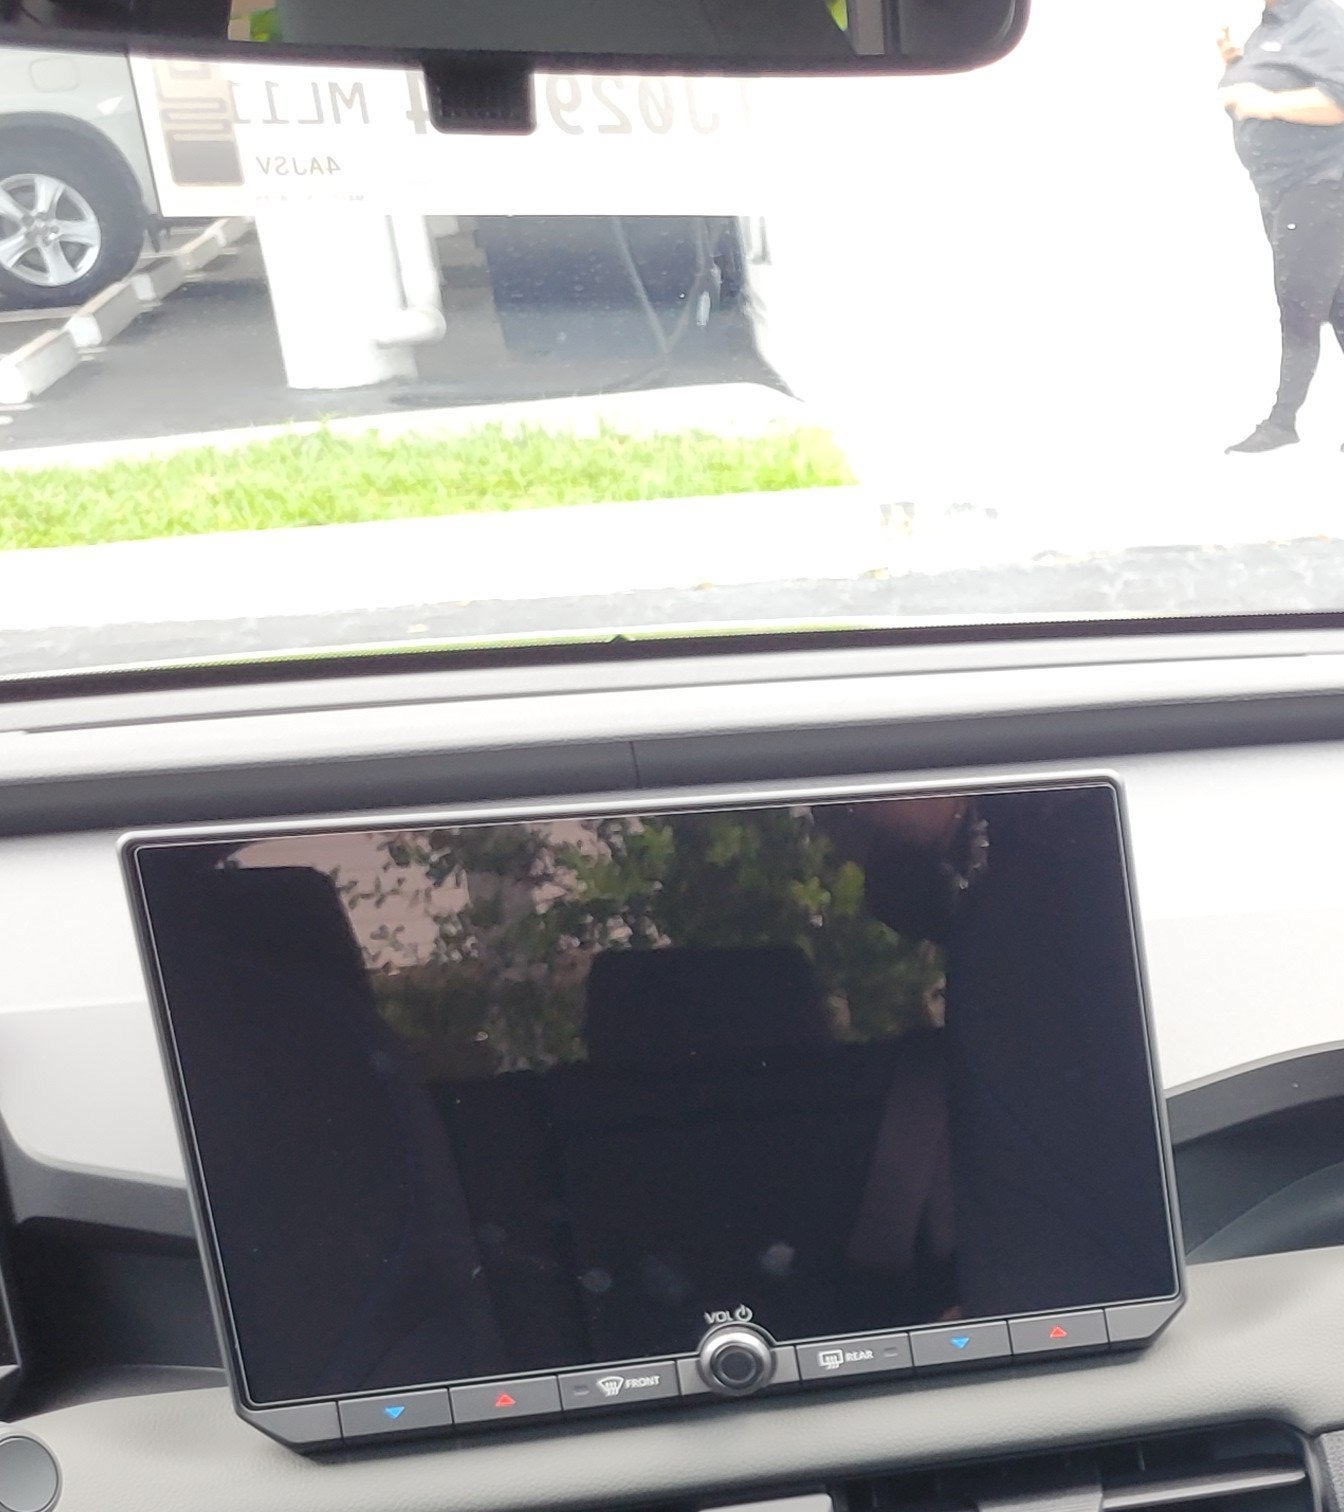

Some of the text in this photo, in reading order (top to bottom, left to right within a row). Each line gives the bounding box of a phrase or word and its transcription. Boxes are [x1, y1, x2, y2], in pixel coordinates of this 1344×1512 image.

[704, 1312, 734, 1324] VOL
[846, 1350, 874, 1361] REAR
[624, 1375, 660, 1389] FRONT
